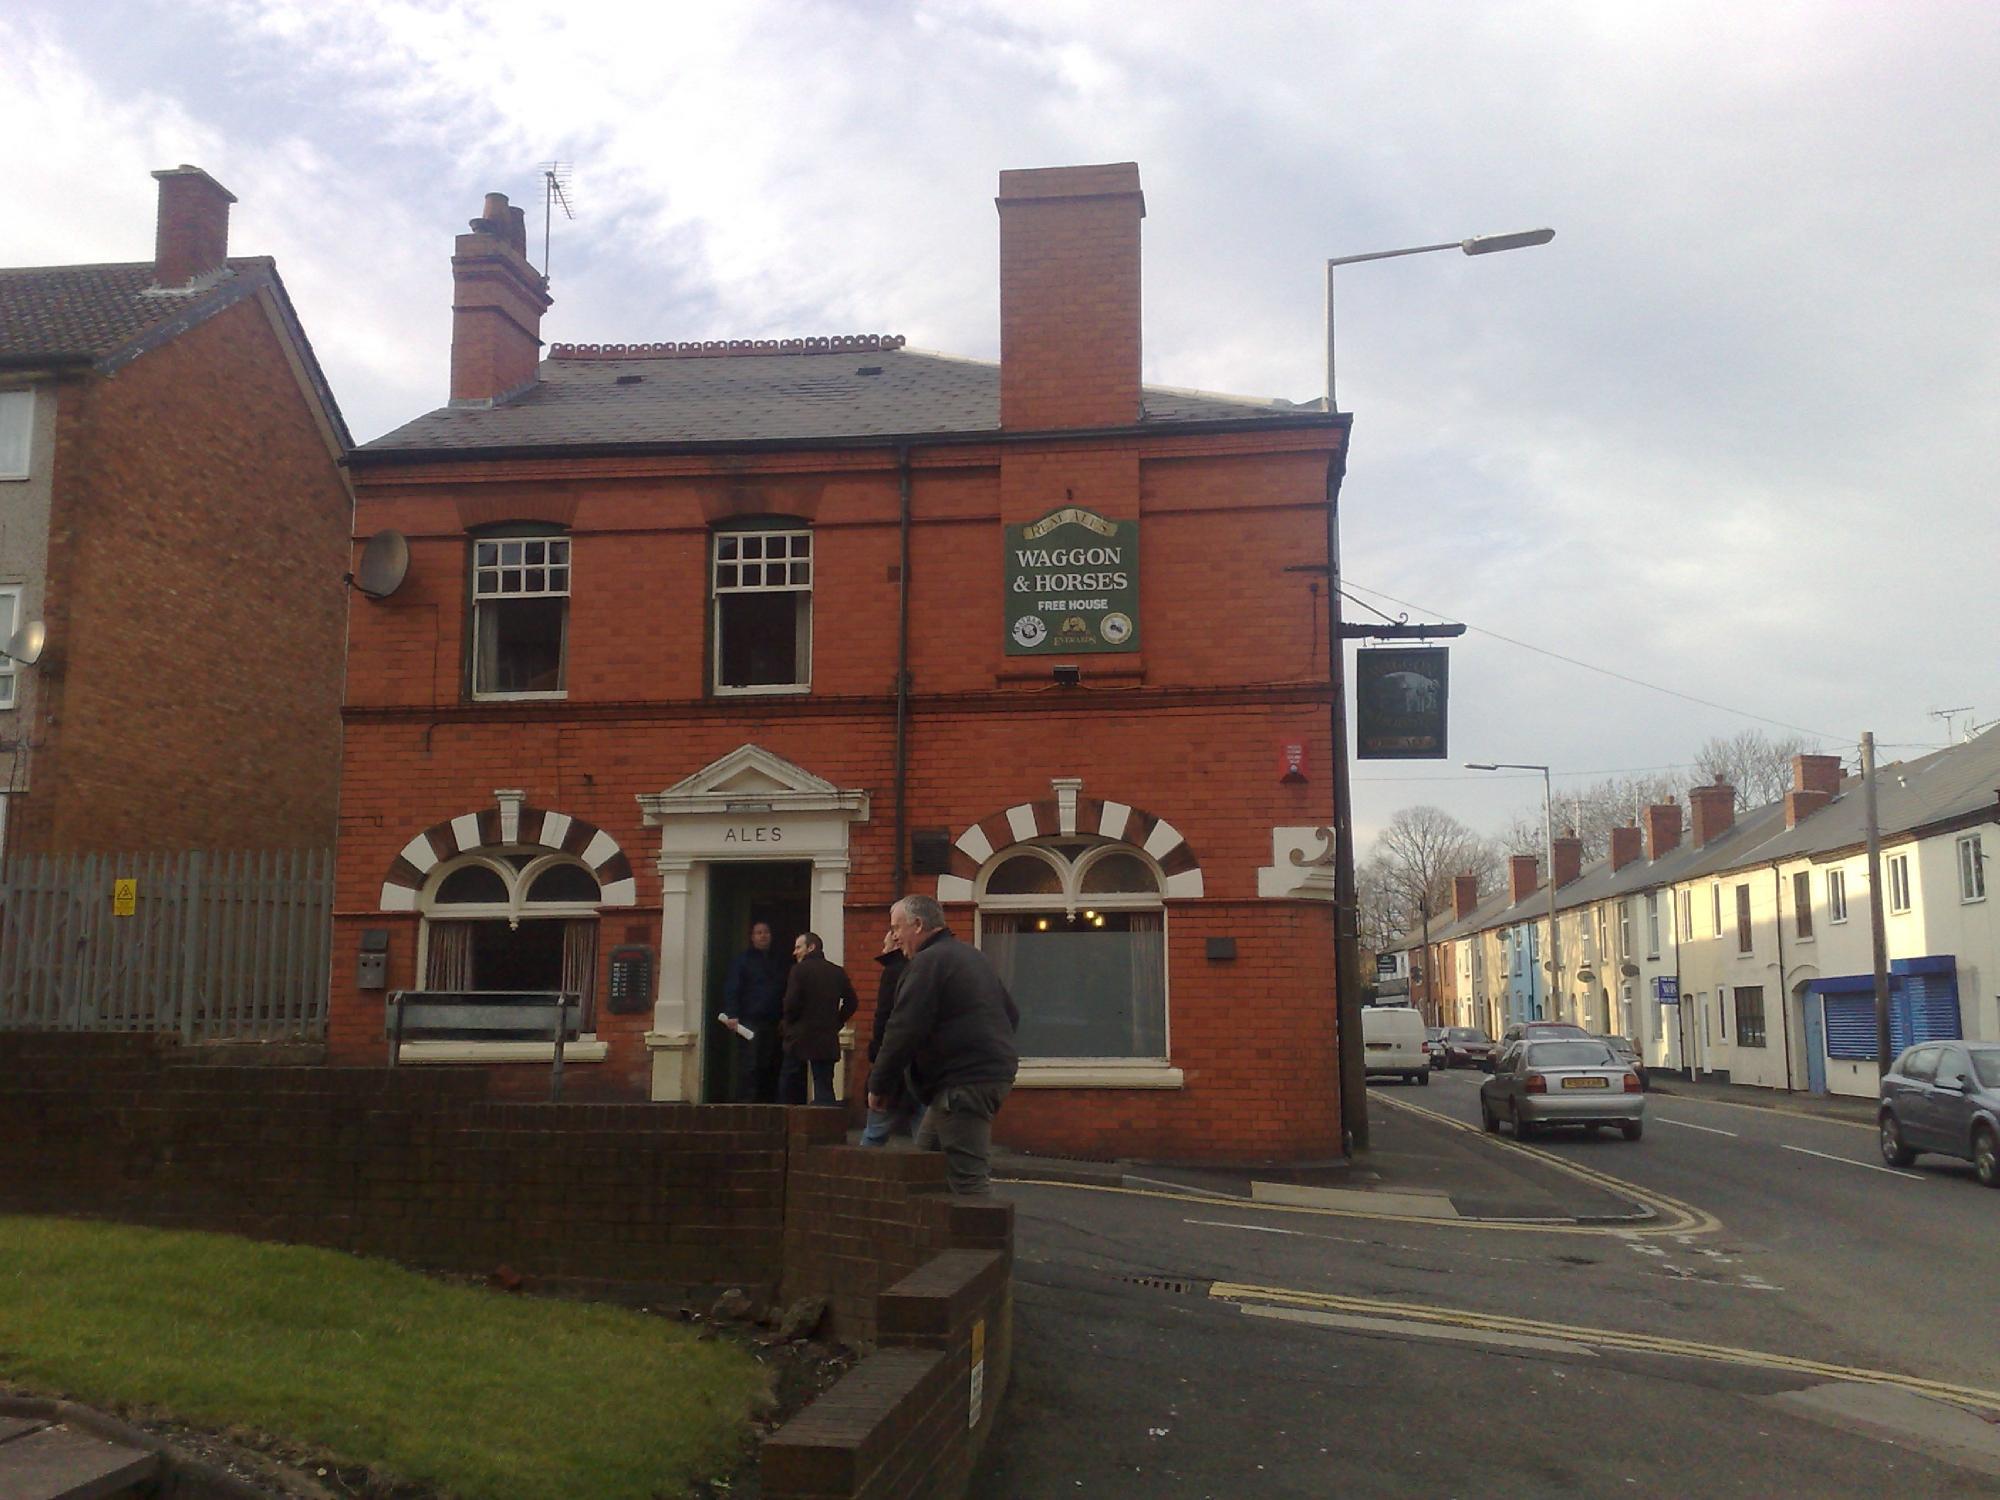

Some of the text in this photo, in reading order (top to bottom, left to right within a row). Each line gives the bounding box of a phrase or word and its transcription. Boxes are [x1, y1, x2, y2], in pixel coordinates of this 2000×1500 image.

[1074, 510, 1108, 533] ALES
[1016, 547, 1122, 568] WAGGON
[1012, 572, 1128, 593] & HORSES
[1037, 599, 1109, 612] FREE HOUSE
[724, 827, 782, 843] ALES
